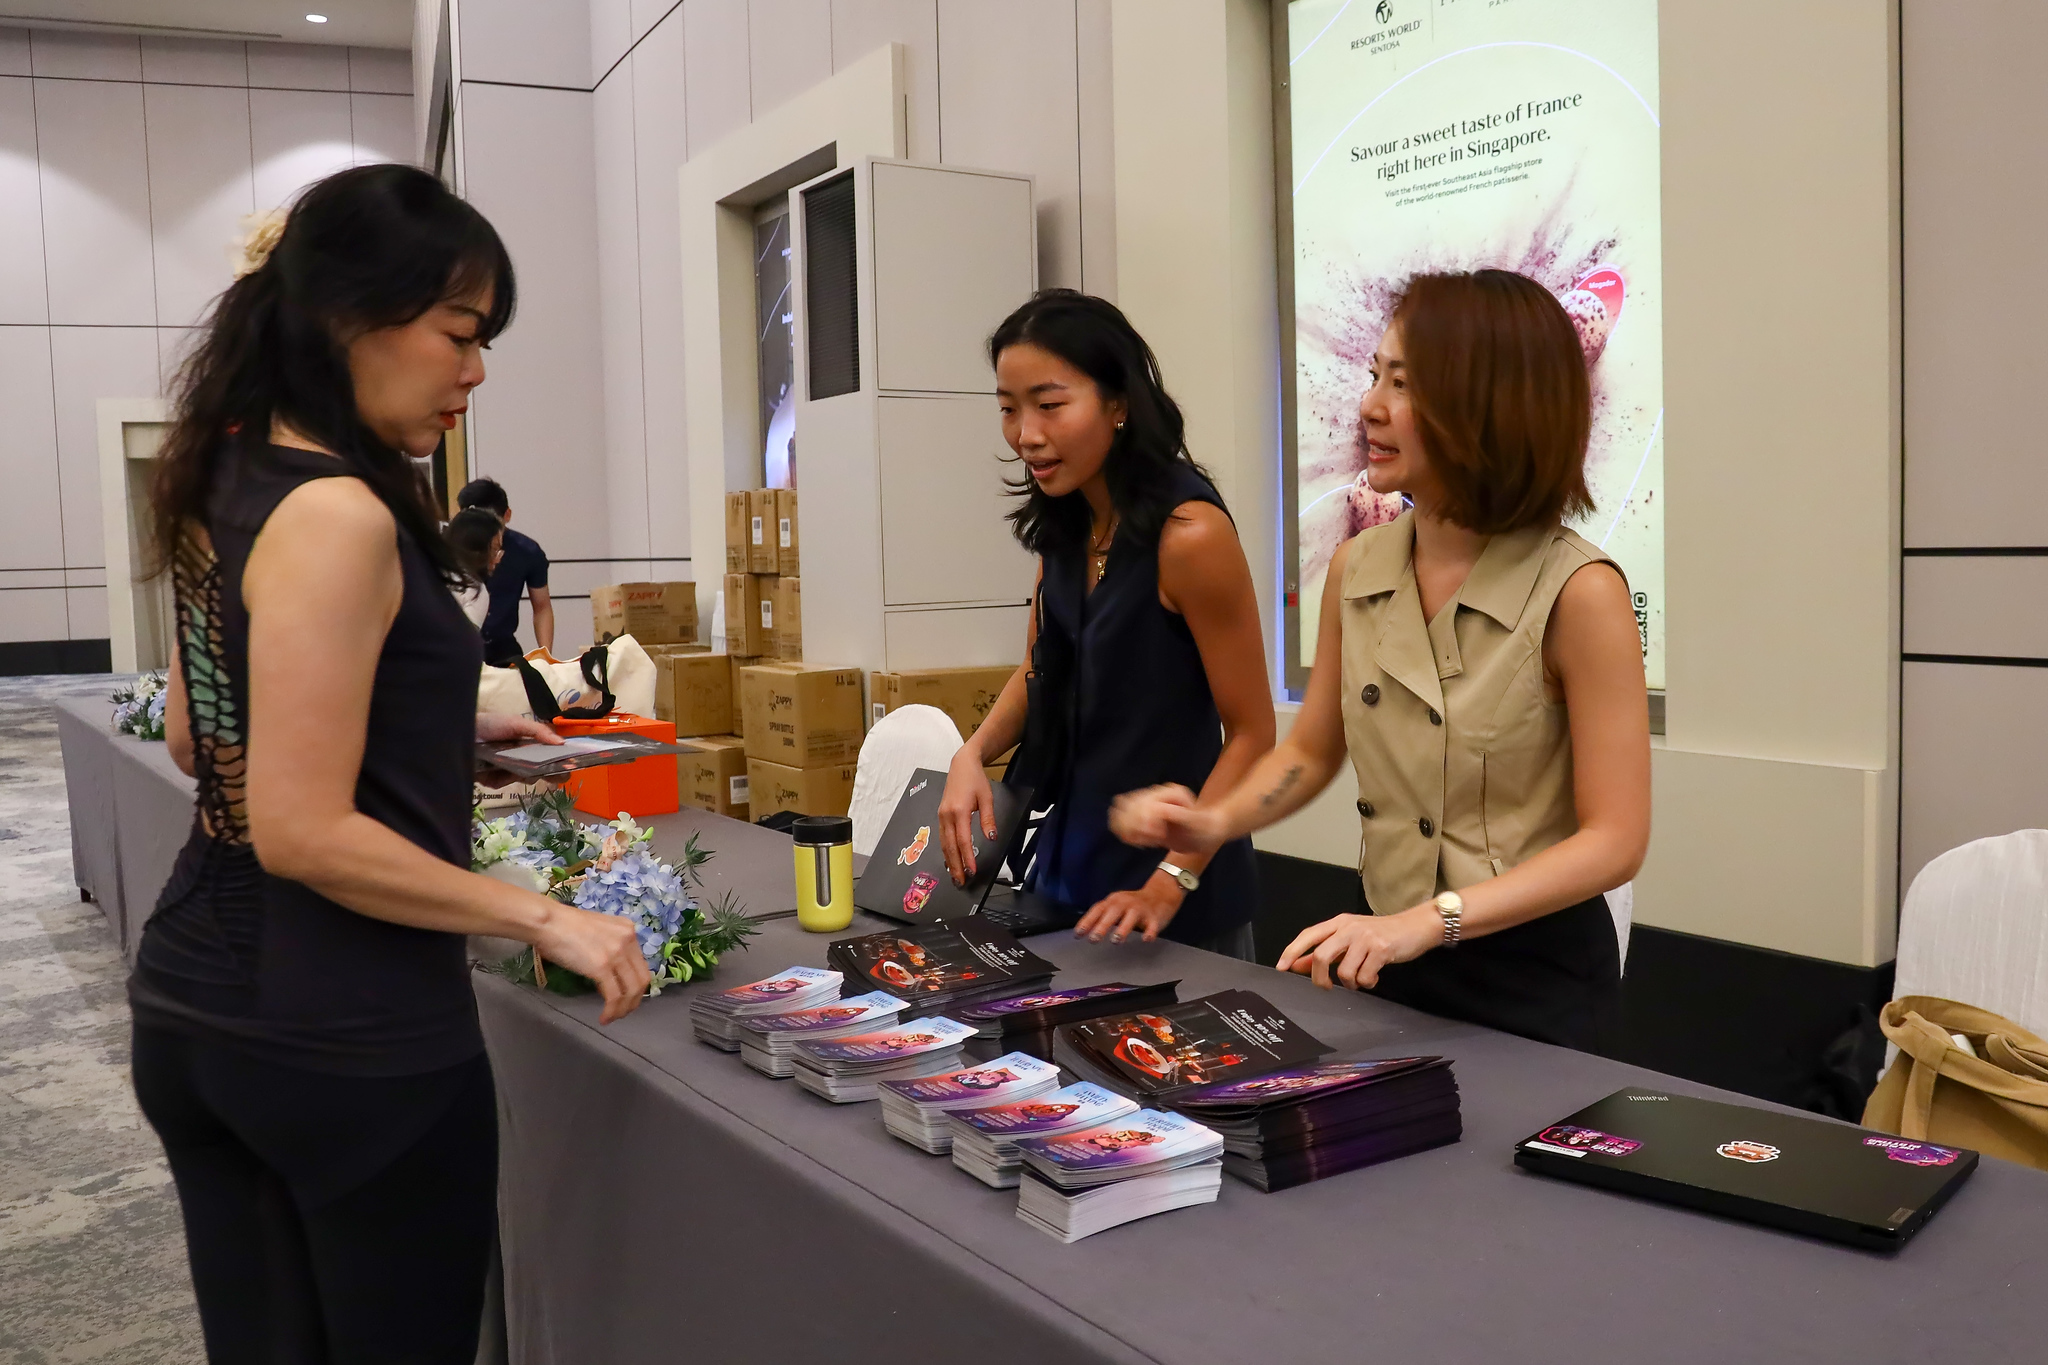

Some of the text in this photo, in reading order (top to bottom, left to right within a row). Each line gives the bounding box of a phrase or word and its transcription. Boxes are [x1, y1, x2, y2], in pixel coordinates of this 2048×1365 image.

[1351, 19, 1420, 50] RESORTS WORLD
[1371, 40, 1400, 55] SENTOSA
[1350, 93, 1582, 162] Savour a sweet taste of France
[1377, 129, 1551, 181] right here in Singapore.
[1385, 157, 1543, 198] Visit the first-ever Southeast Asia flagship store
[1395, 172, 1530, 207] of the world-renowned French patisserie.
[628, 592, 662, 600] ZAPPY
[775, 696, 792, 706] ZAPPY
[782, 789, 798, 800] ZAPPY
[909, 779, 928, 797] ThinkPad
